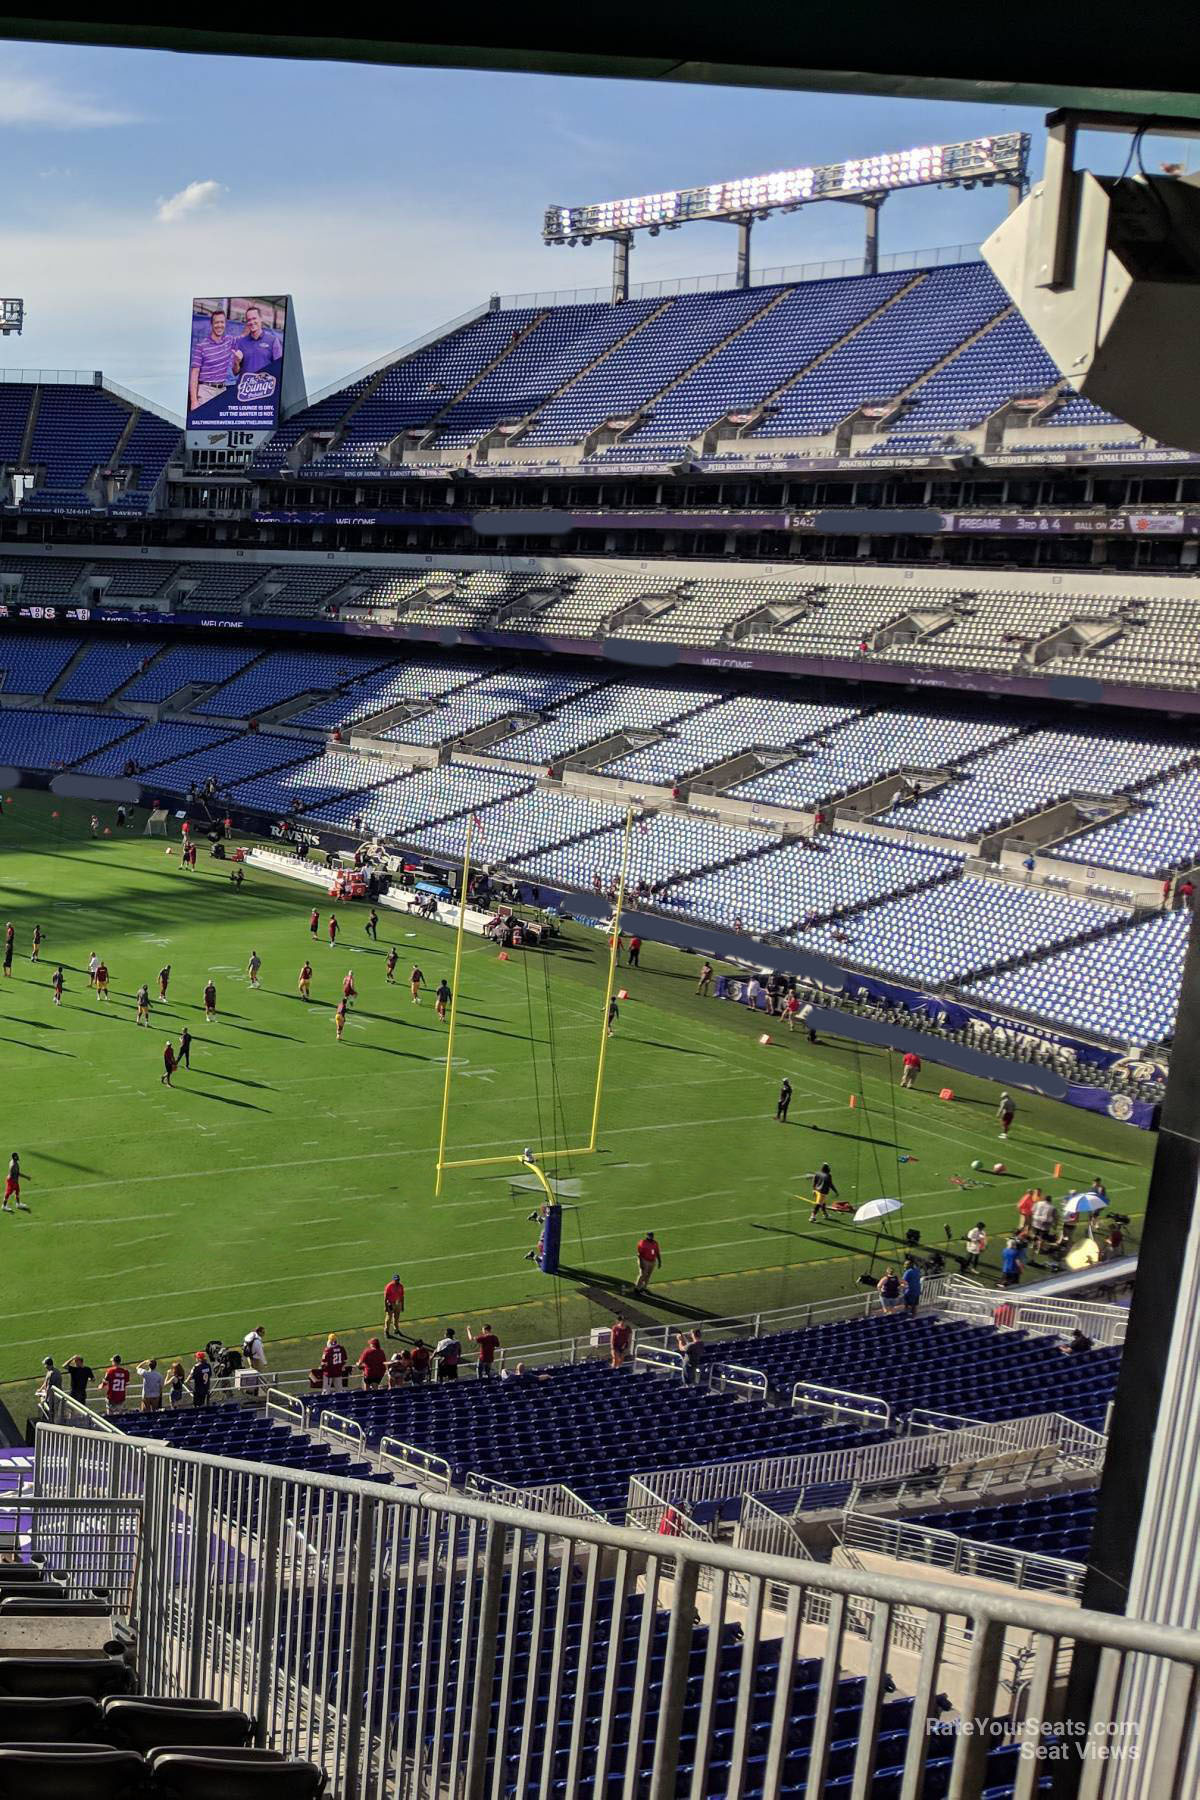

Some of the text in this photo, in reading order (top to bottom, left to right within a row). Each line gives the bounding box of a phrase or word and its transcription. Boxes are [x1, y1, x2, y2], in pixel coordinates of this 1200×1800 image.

[239, 380, 274, 396] Lounge
[227, 431, 254, 448] Lite
[1095, 453, 1119, 462] JAMAL
[1121, 452, 1145, 461] LEWIS
[959, 518, 1001, 529] PREGAME
[1016, 518, 1061, 530] 3RD & 4
[1074, 522, 1093, 530] BALL
[1109, 518, 1125, 530] 25
[990, 1015, 1060, 1042] BALTIMORE
[332, 1352, 342, 1365] 21
[112, 1378, 125, 1392] 21
[202, 1372, 209, 1385] 9
